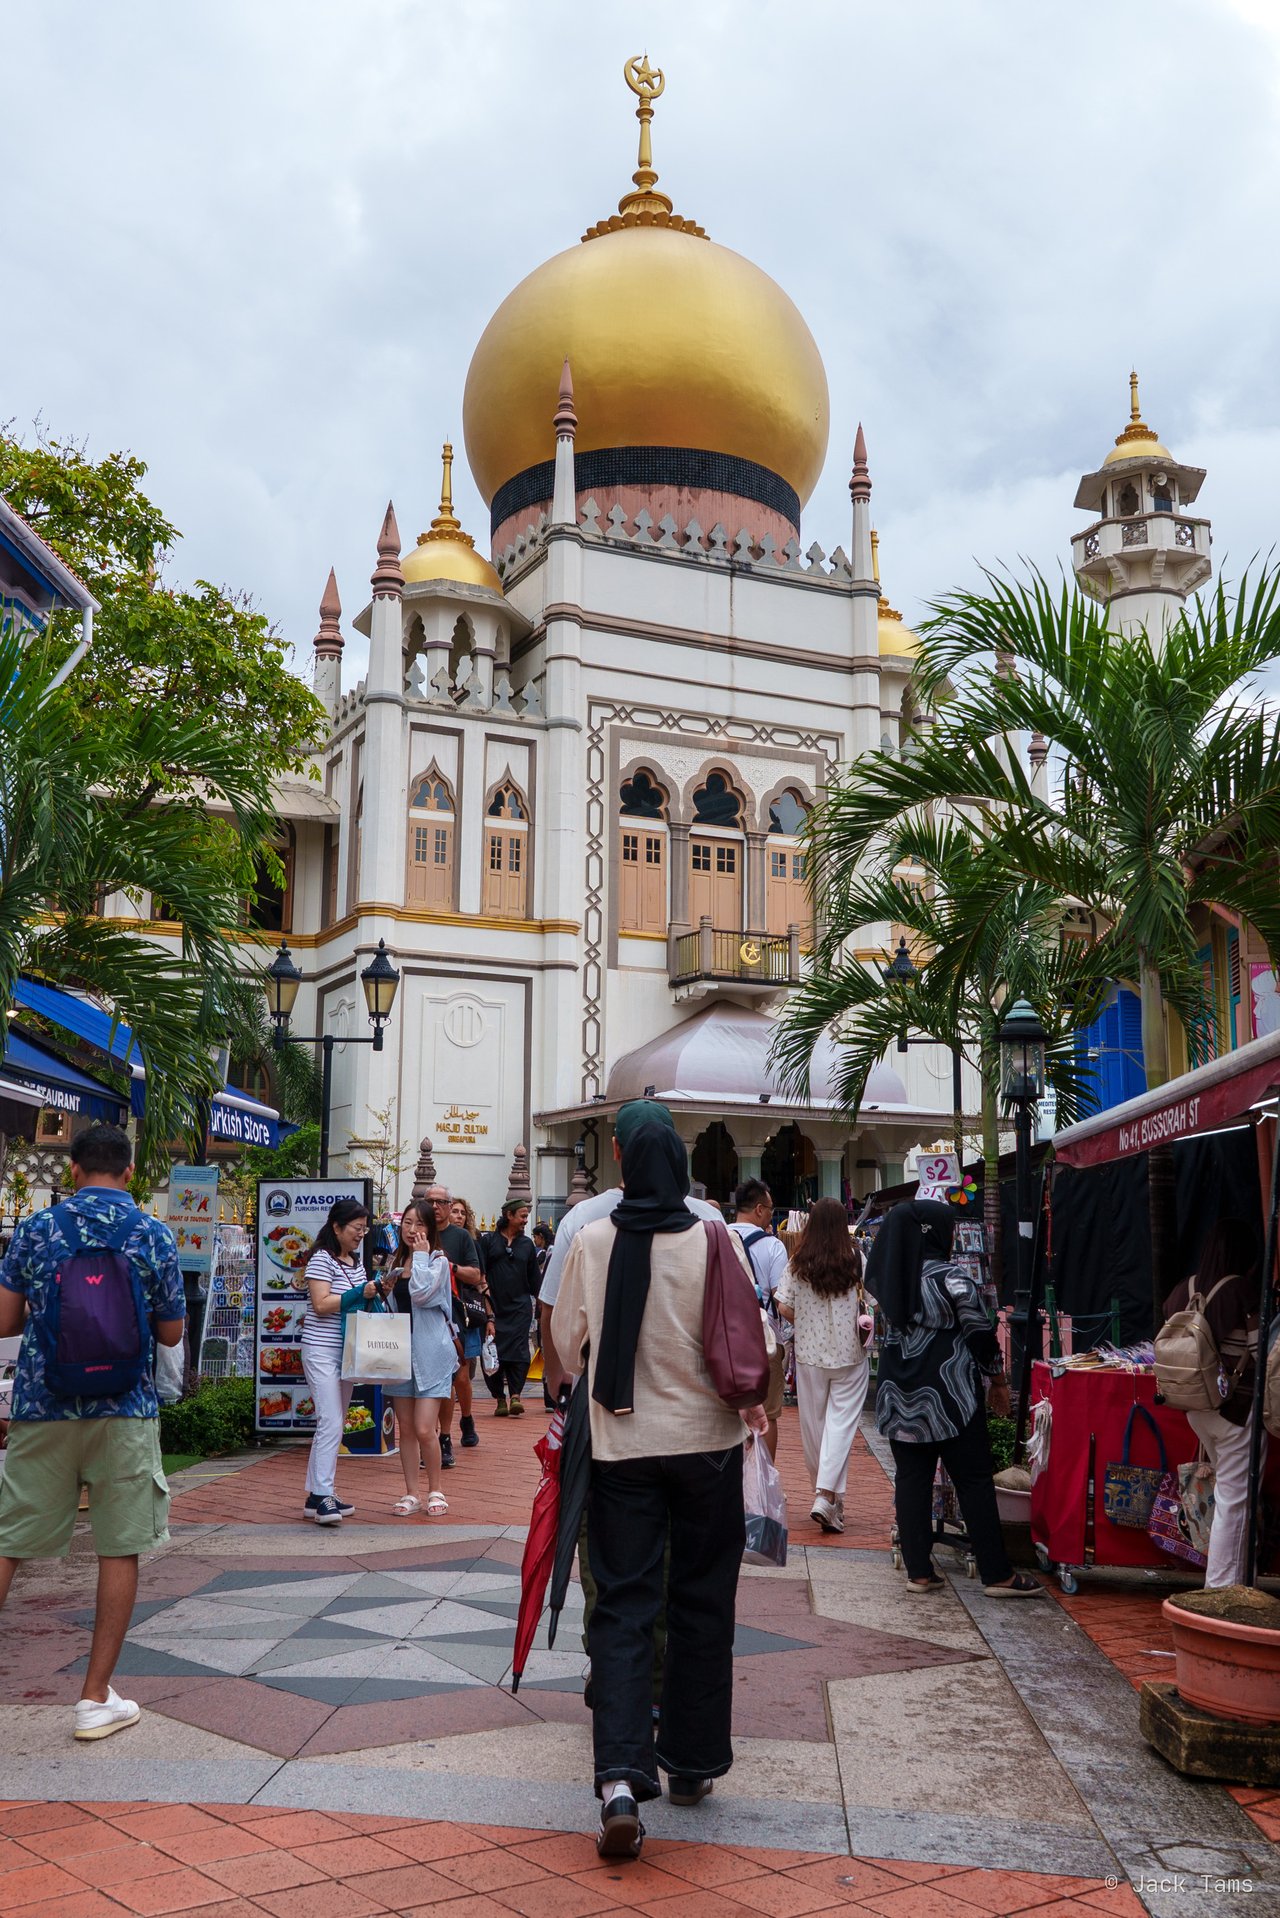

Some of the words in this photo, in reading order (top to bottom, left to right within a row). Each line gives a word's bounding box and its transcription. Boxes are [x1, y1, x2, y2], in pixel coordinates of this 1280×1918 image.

[210, 1106, 242, 1139] urkish
[244, 1115, 270, 1145] Store
[435, 1122, 460, 1133] MASJID
[464, 1124, 488, 1135] SULTAN
[1119, 1128, 1129, 1151] No
[1130, 1123, 1140, 1150] 41,
[1141, 1103, 1186, 1144] BUSSORAH
[1189, 1097, 1200, 1127] ST
[926, 1158, 952, 1181] $2
